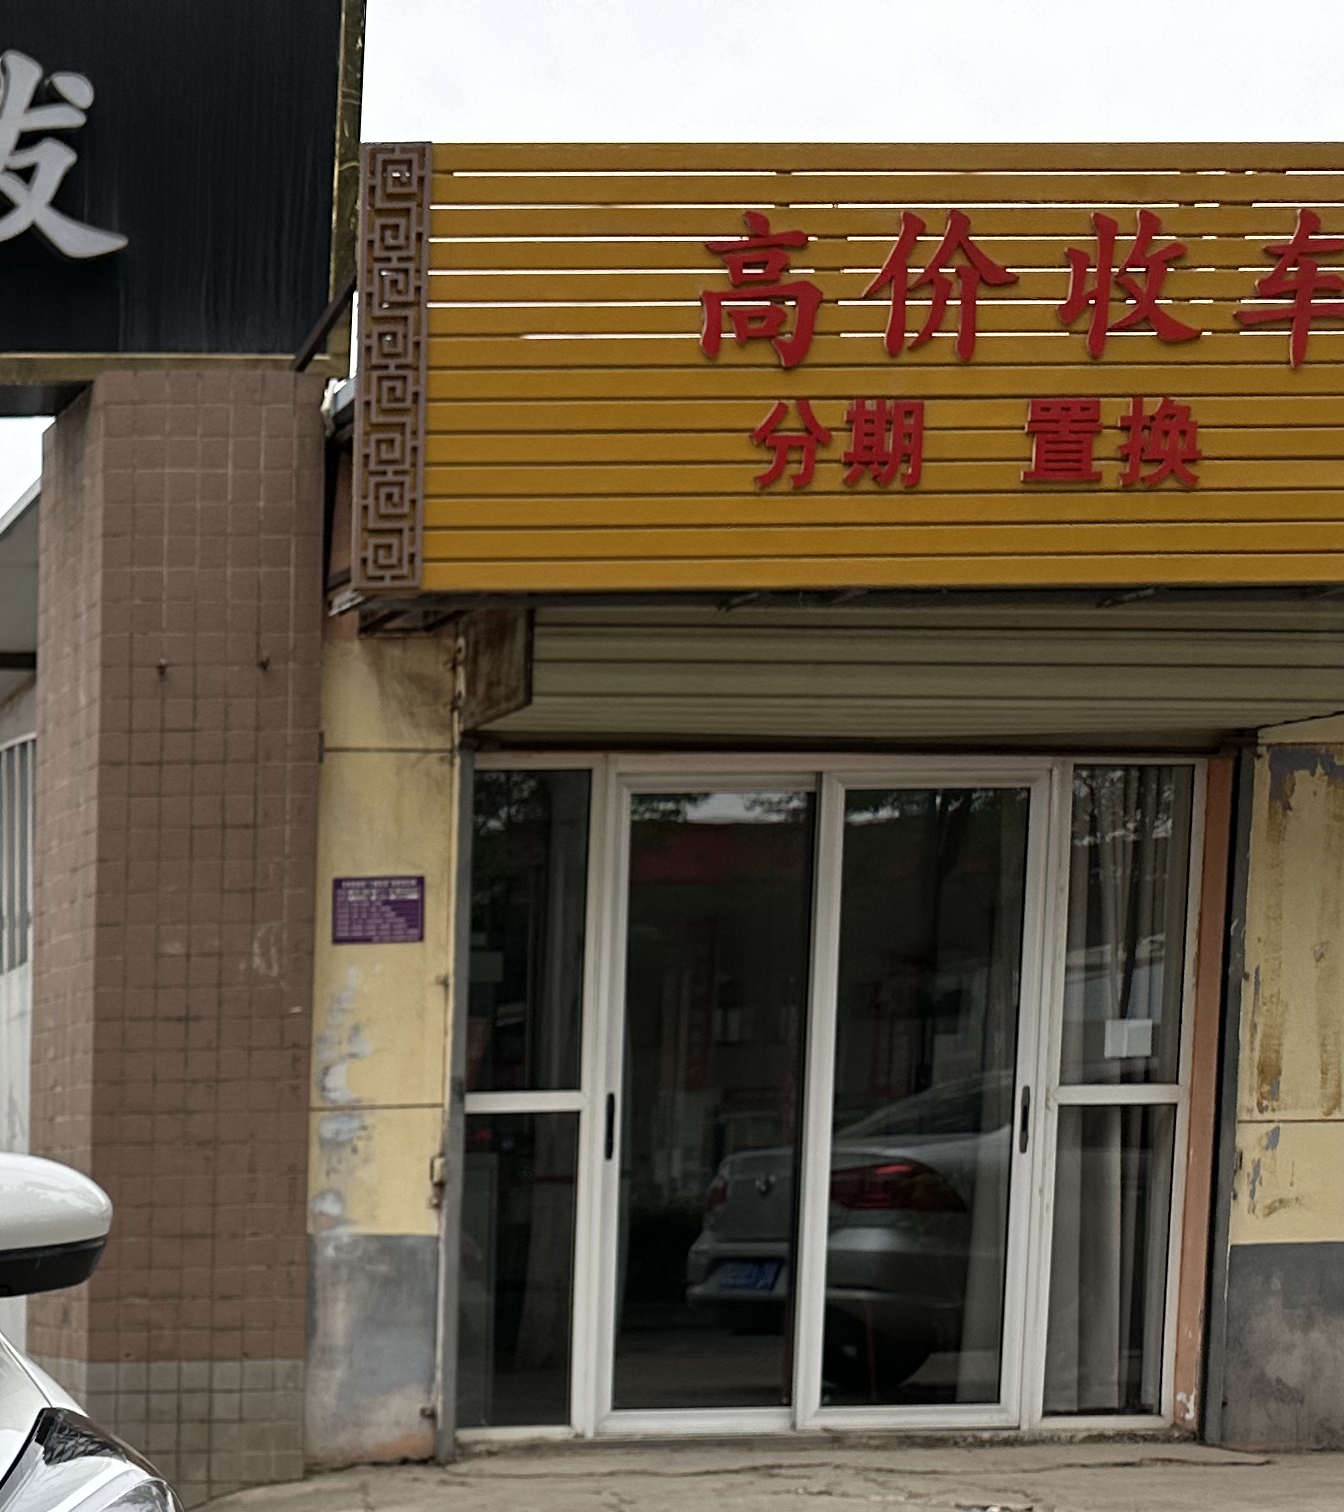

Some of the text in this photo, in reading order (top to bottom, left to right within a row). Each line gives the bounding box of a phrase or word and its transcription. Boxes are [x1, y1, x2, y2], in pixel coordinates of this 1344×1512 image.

[700, 208, 1344, 368] 高价收车
[751, 398, 1202, 488] 分期 置换
